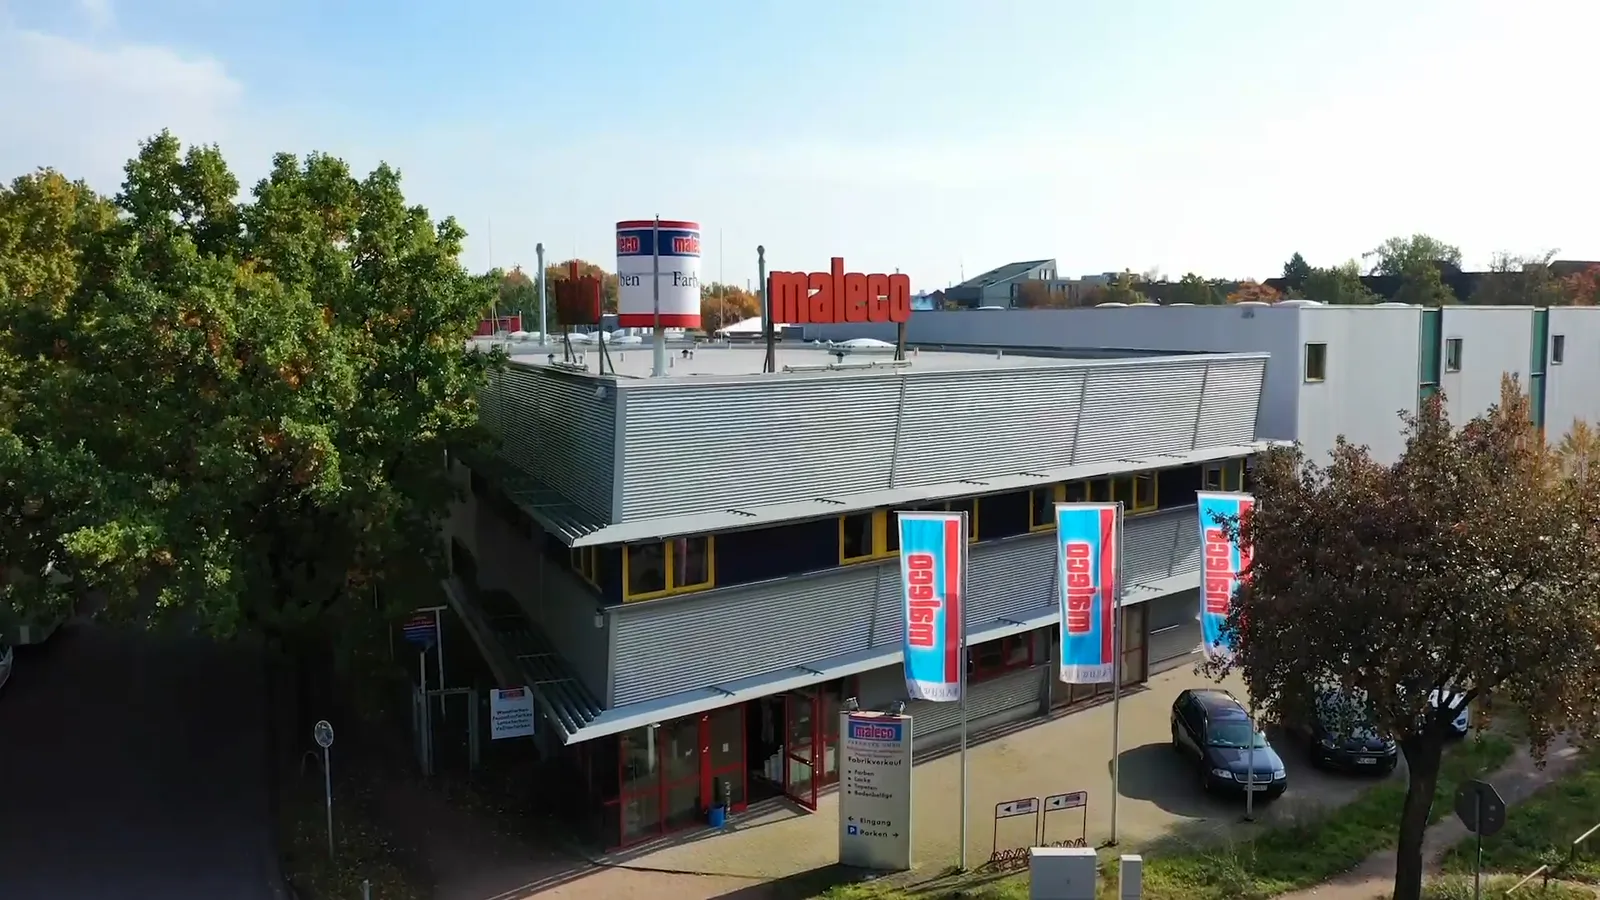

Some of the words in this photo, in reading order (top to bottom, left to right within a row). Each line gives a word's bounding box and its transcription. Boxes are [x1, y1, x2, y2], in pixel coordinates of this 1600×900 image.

[768, 257, 911, 324] maleco
[855, 725, 894, 738] maleco
[848, 756, 902, 766] Fabrikverkauf
[860, 818, 892, 827] Eingang
[860, 829, 888, 838] Parken
